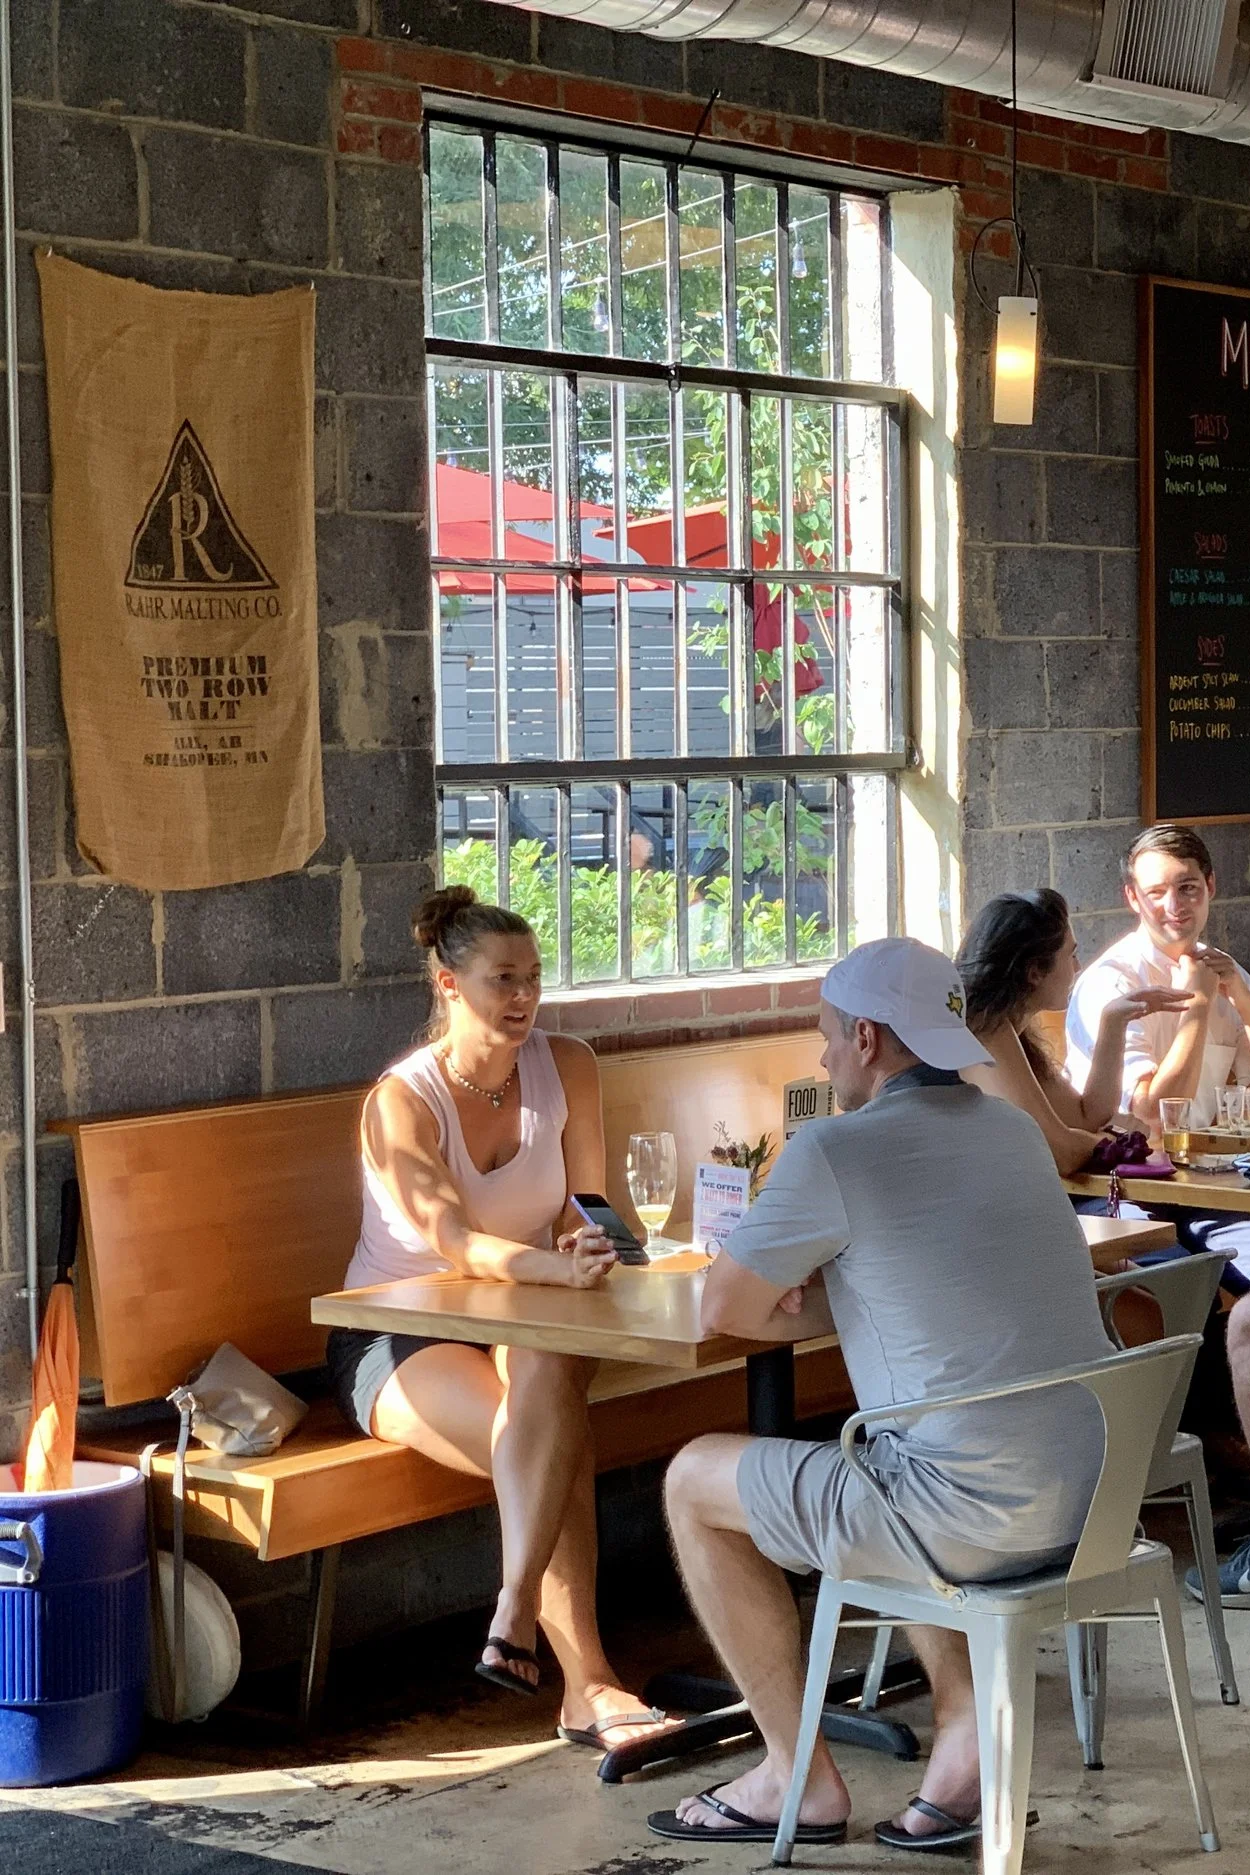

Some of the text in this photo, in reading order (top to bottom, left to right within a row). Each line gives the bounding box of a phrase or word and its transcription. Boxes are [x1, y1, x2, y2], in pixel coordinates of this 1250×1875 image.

[1189, 414, 1231, 440] TOASTS
[1165, 450, 1194, 470] SMOKED
[1198, 453, 1219, 471] GOUDA
[1165, 477, 1195, 495] PIMENTO
[1197, 479, 1205, 496] &
[1194, 531, 1228, 554] SALADS
[1169, 567, 1200, 585] CAESAR
[125, 593, 282, 620] RAHR MALTING CO.
[1197, 635, 1225, 661] SIDES
[143, 655, 267, 677] PREMIUM
[141, 676, 271, 698] TWO ROW
[1169, 675, 1199, 691] ARDENT
[1202, 673, 1218, 689] SPICY
[1221, 672, 1240, 687] SLAW
[168, 700, 241, 720] MALT
[1169, 697, 1210, 713] CUCUMBER
[1214, 696, 1236, 711] SALAD
[1169, 719, 1201, 742] POTATO
[1205, 722, 1231, 739] CHIPS
[788, 1088, 817, 1118] FOOD
[702, 1181, 743, 1194] WE OFFER
